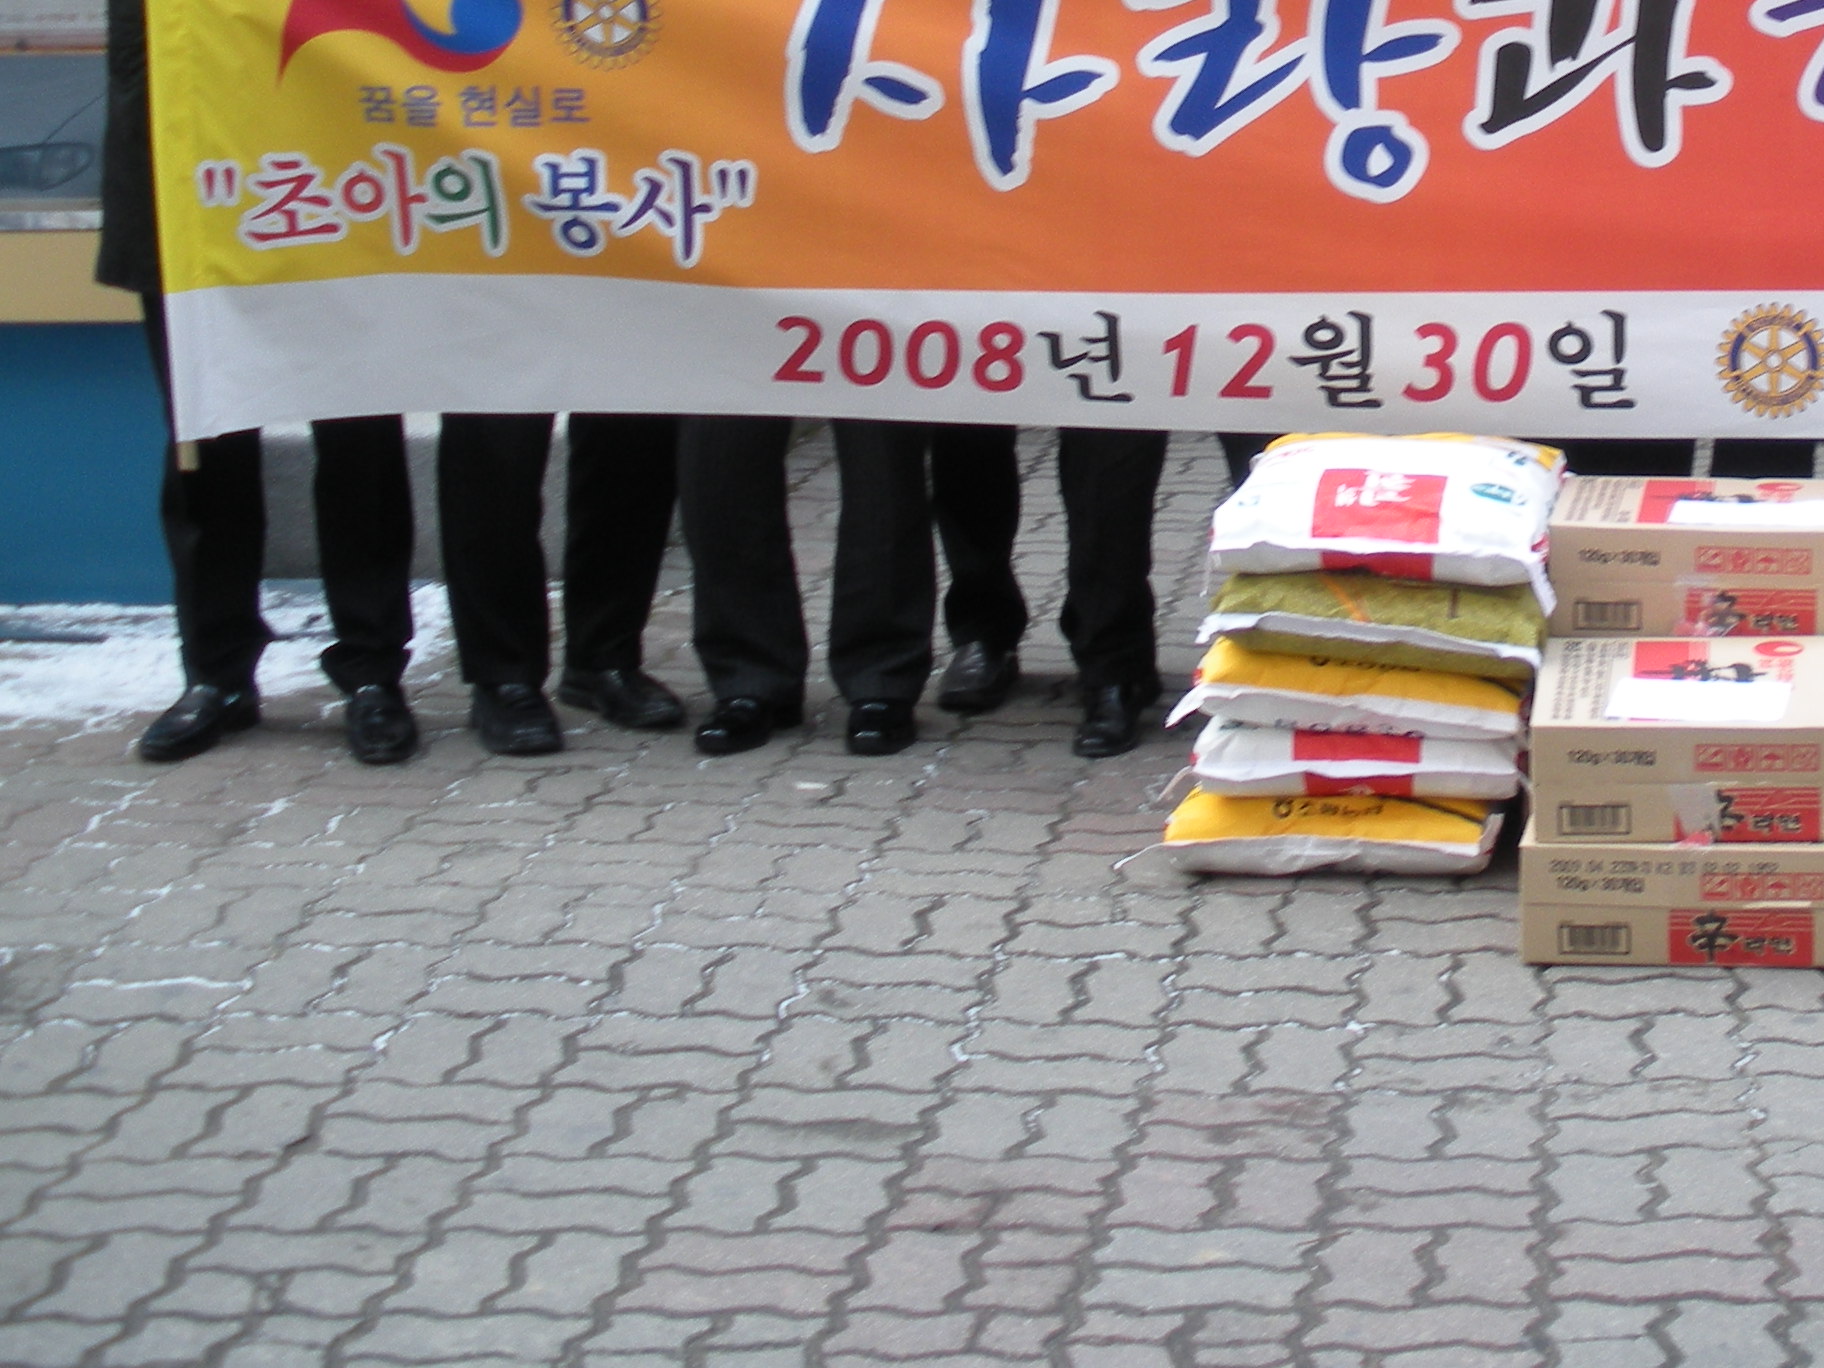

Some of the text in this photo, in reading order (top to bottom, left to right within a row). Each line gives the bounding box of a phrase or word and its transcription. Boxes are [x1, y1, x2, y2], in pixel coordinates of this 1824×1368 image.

[358, 84, 592, 129] 꿈을 현실로
[202, 148, 752, 263] "초아의 봉사"
[773, 308, 1638, 412] 2008년 12월 30일
